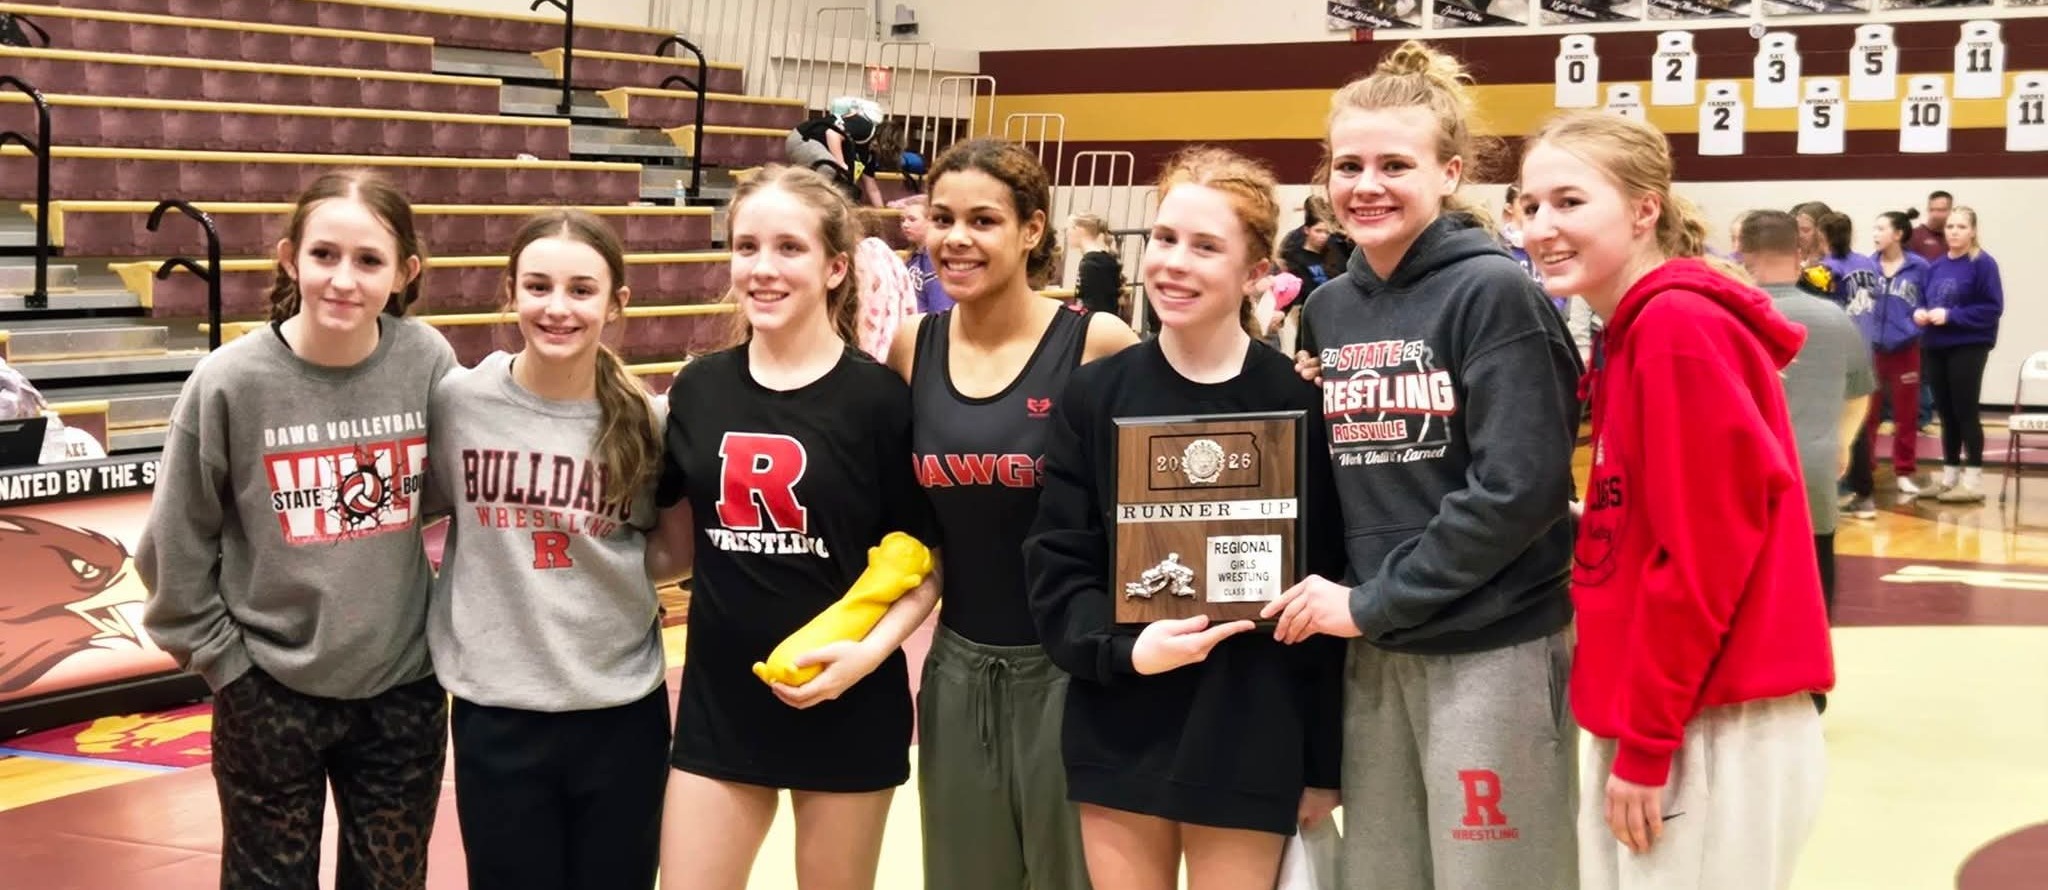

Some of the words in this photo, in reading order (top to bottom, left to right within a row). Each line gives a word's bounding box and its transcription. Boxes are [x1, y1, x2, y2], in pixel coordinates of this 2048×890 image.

[1568, 61, 1585, 83] 0
[1666, 59, 1682, 81] 2
[1768, 60, 1786, 83] 3
[1865, 52, 1883, 75] 5
[1966, 49, 1993, 72] 11
[1713, 108, 1730, 130] 2
[1813, 106, 1831, 129] 5
[1909, 103, 1941, 126] 10
[2018, 101, 2045, 125] 11
[1337, 340, 1404, 371] STATE
[264, 424, 319, 446] DAWG
[327, 411, 425, 440] VOLLEYBAL
[1333, 420, 1407, 443] ROSSVILLE
[1156, 456, 1178, 471] 20
[1229, 454, 1251, 469] 26
[1402, 445, 1446, 463] Earned
[66, 468, 92, 493] BY
[99, 464, 137, 490] THE
[715, 431, 807, 534] R
[273, 489, 322, 511] STATE
[403, 474, 425, 495] BO
[532, 531, 573, 569] R
[1215, 541, 1272, 554] REGIONAL
[1231, 559, 1256, 570] GIRLS
[1218, 571, 1270, 582] WRESTLING
[1224, 588, 1245, 596] CLASS
[1457, 770, 1507, 826] R
